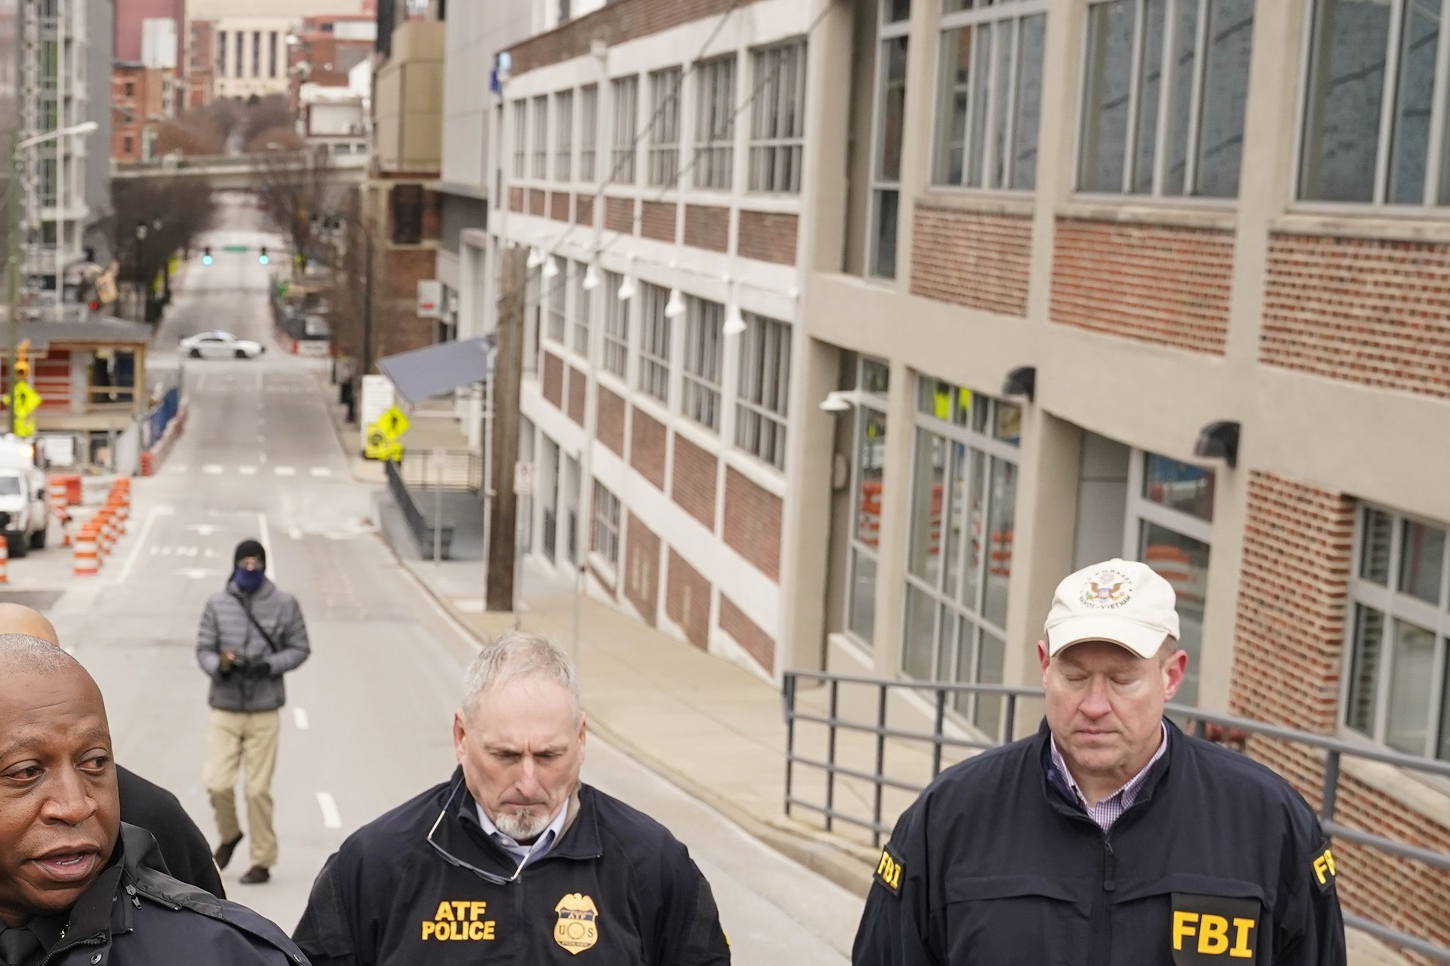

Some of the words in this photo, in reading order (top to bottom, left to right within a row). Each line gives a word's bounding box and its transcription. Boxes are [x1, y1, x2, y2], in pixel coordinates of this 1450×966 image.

[877, 851, 901, 889] FBI
[435, 901, 486, 921] ATF
[568, 911, 586, 920] ATF
[421, 921, 495, 941] POLICE
[559, 925, 566, 935] U
[587, 927, 594, 938] S
[1173, 911, 1255, 958] FBI
